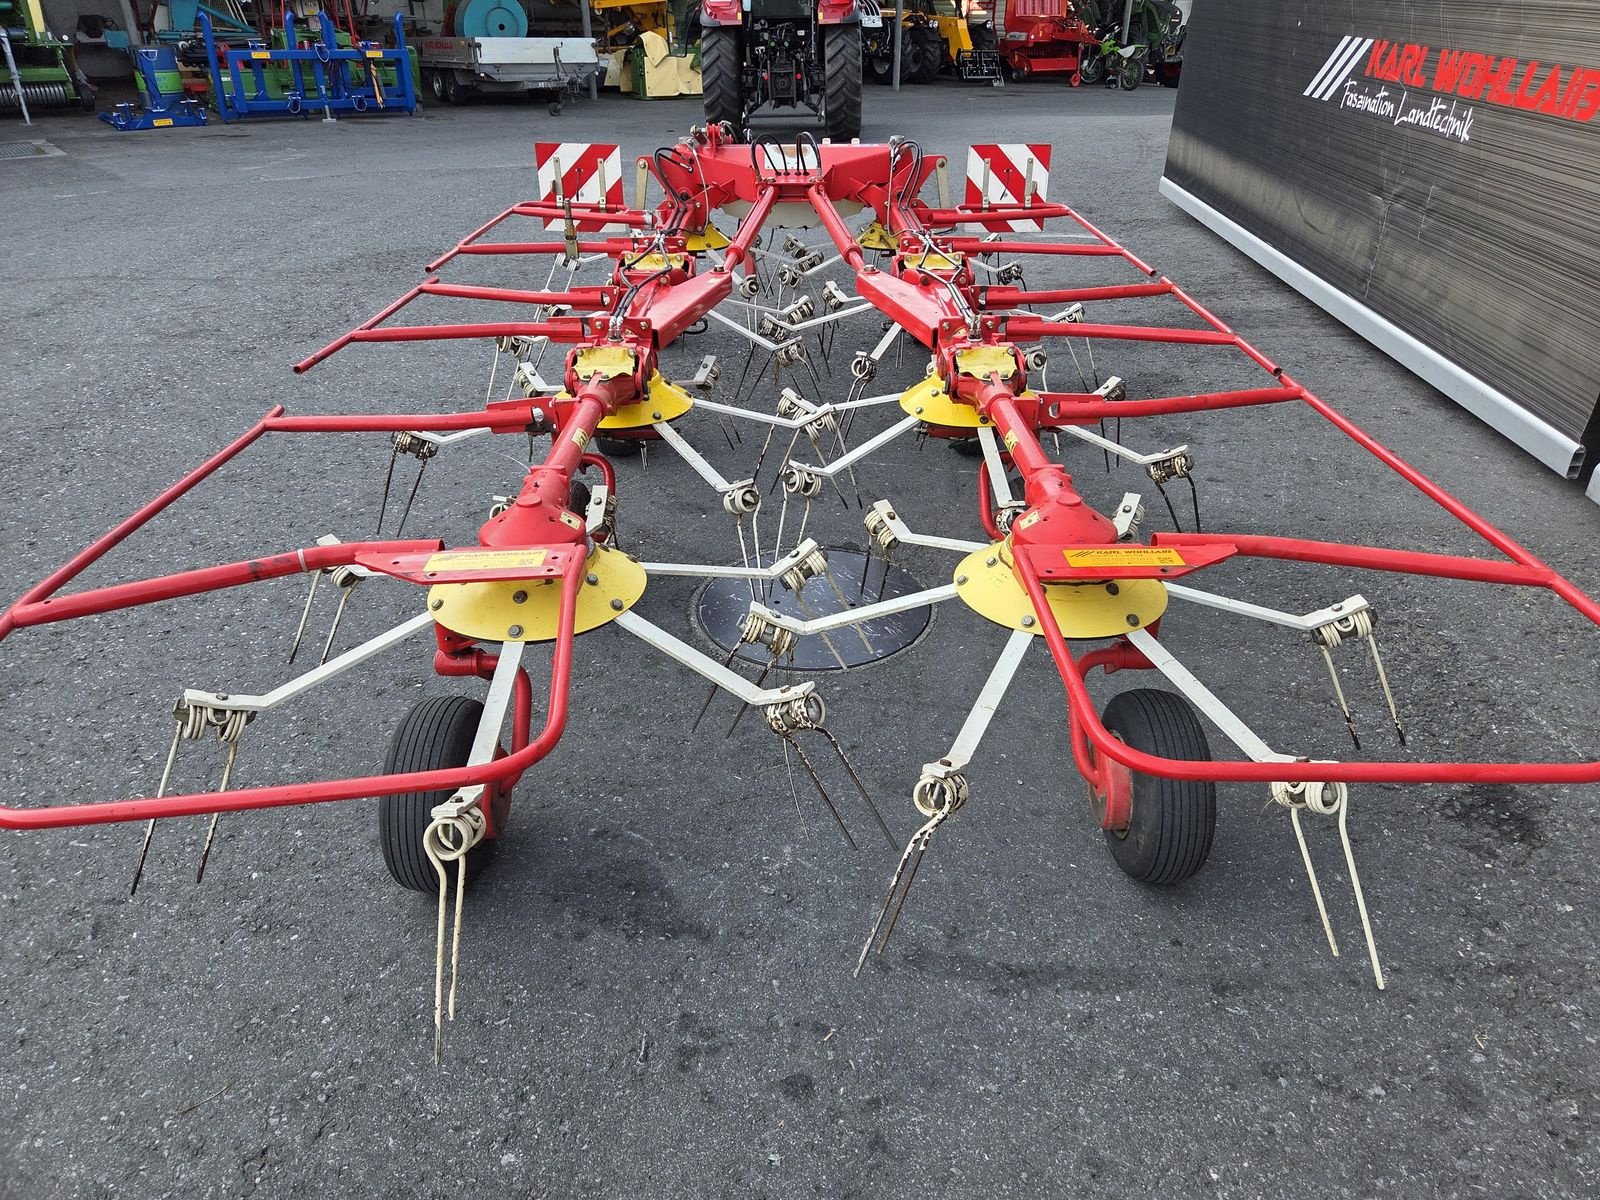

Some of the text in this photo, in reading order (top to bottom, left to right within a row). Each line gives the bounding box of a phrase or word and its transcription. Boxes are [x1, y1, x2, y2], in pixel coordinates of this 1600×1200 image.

[1341, 78, 1474, 142] Faszination Landtechnik
[1365, 40, 1600, 122] KARL WOHLLAIB
